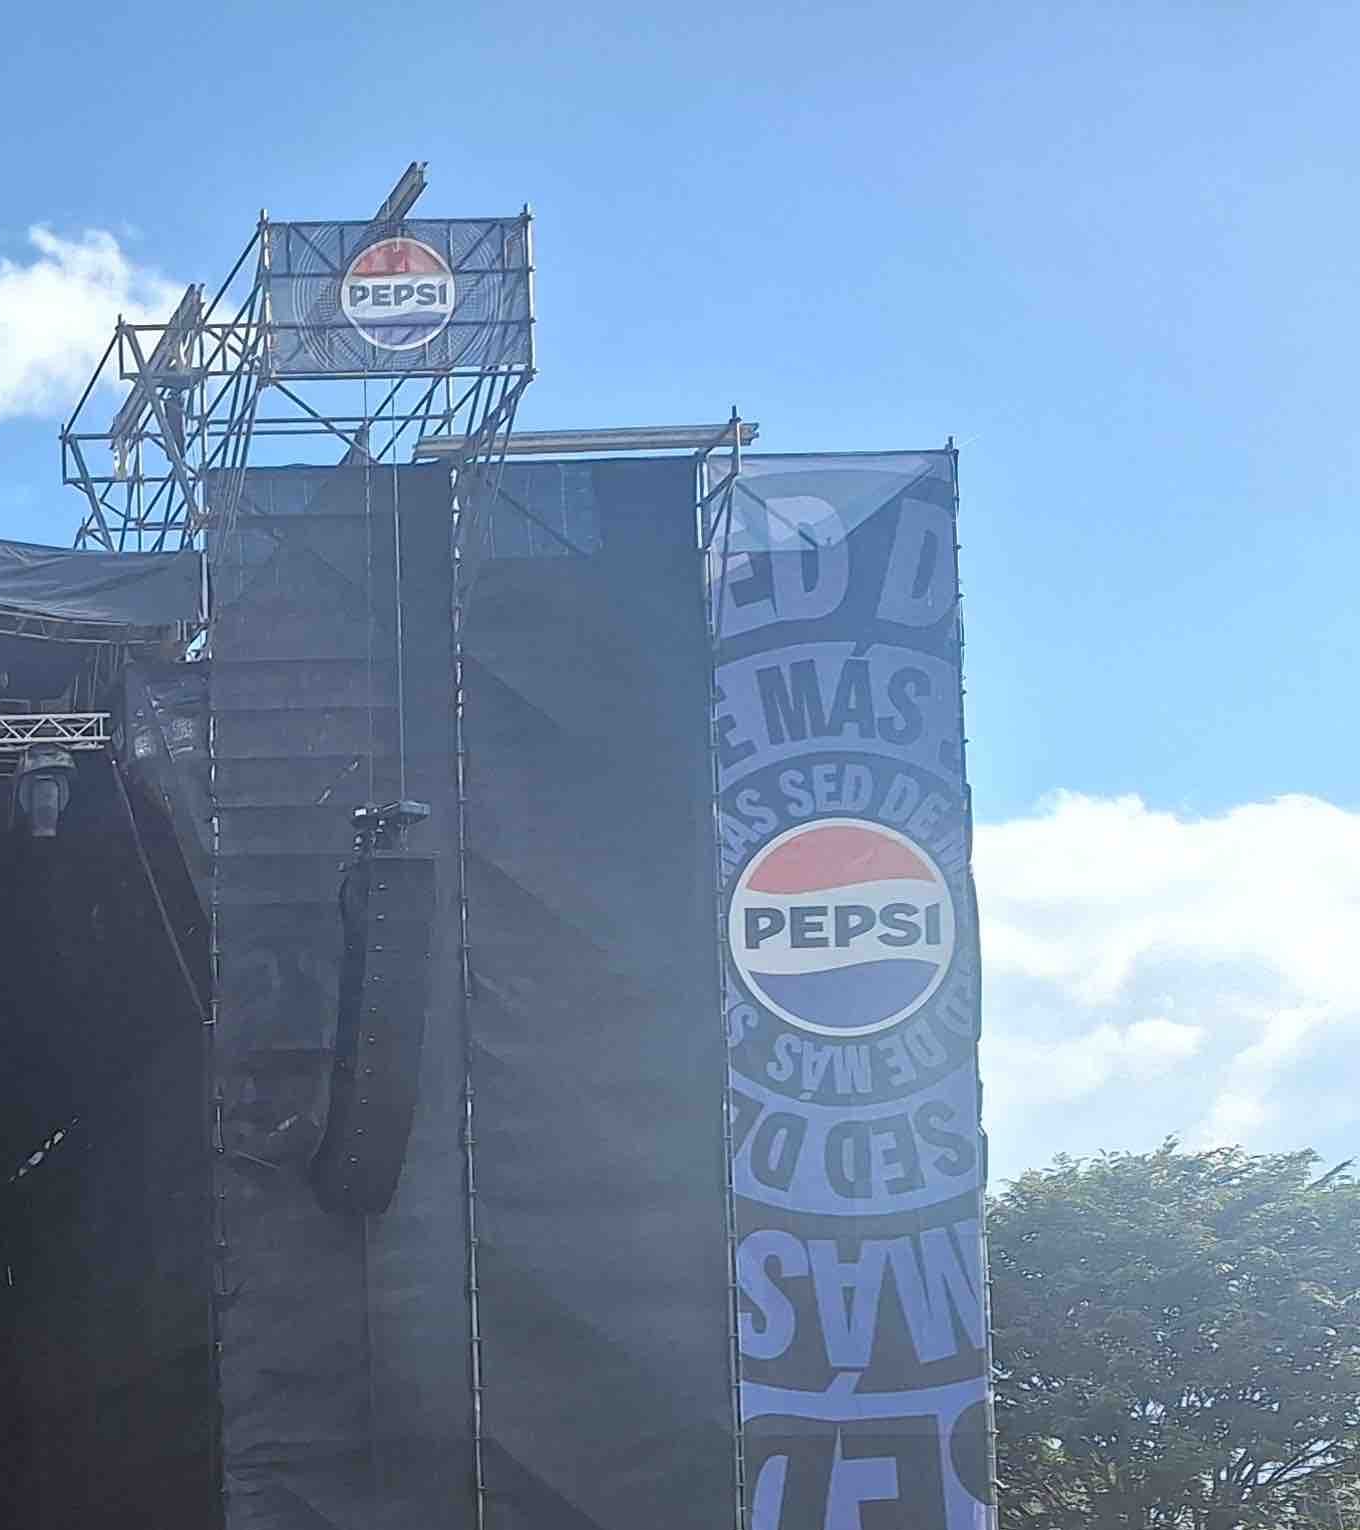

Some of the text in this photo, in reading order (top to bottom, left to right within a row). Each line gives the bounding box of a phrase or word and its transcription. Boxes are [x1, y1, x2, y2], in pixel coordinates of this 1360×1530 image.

[349, 283, 448, 307] PEPSI
[779, 763, 874, 818] SED
[878, 773, 954, 841] DE
[744, 901, 942, 949] PEPSI
[825, 1101, 978, 1199] SED
